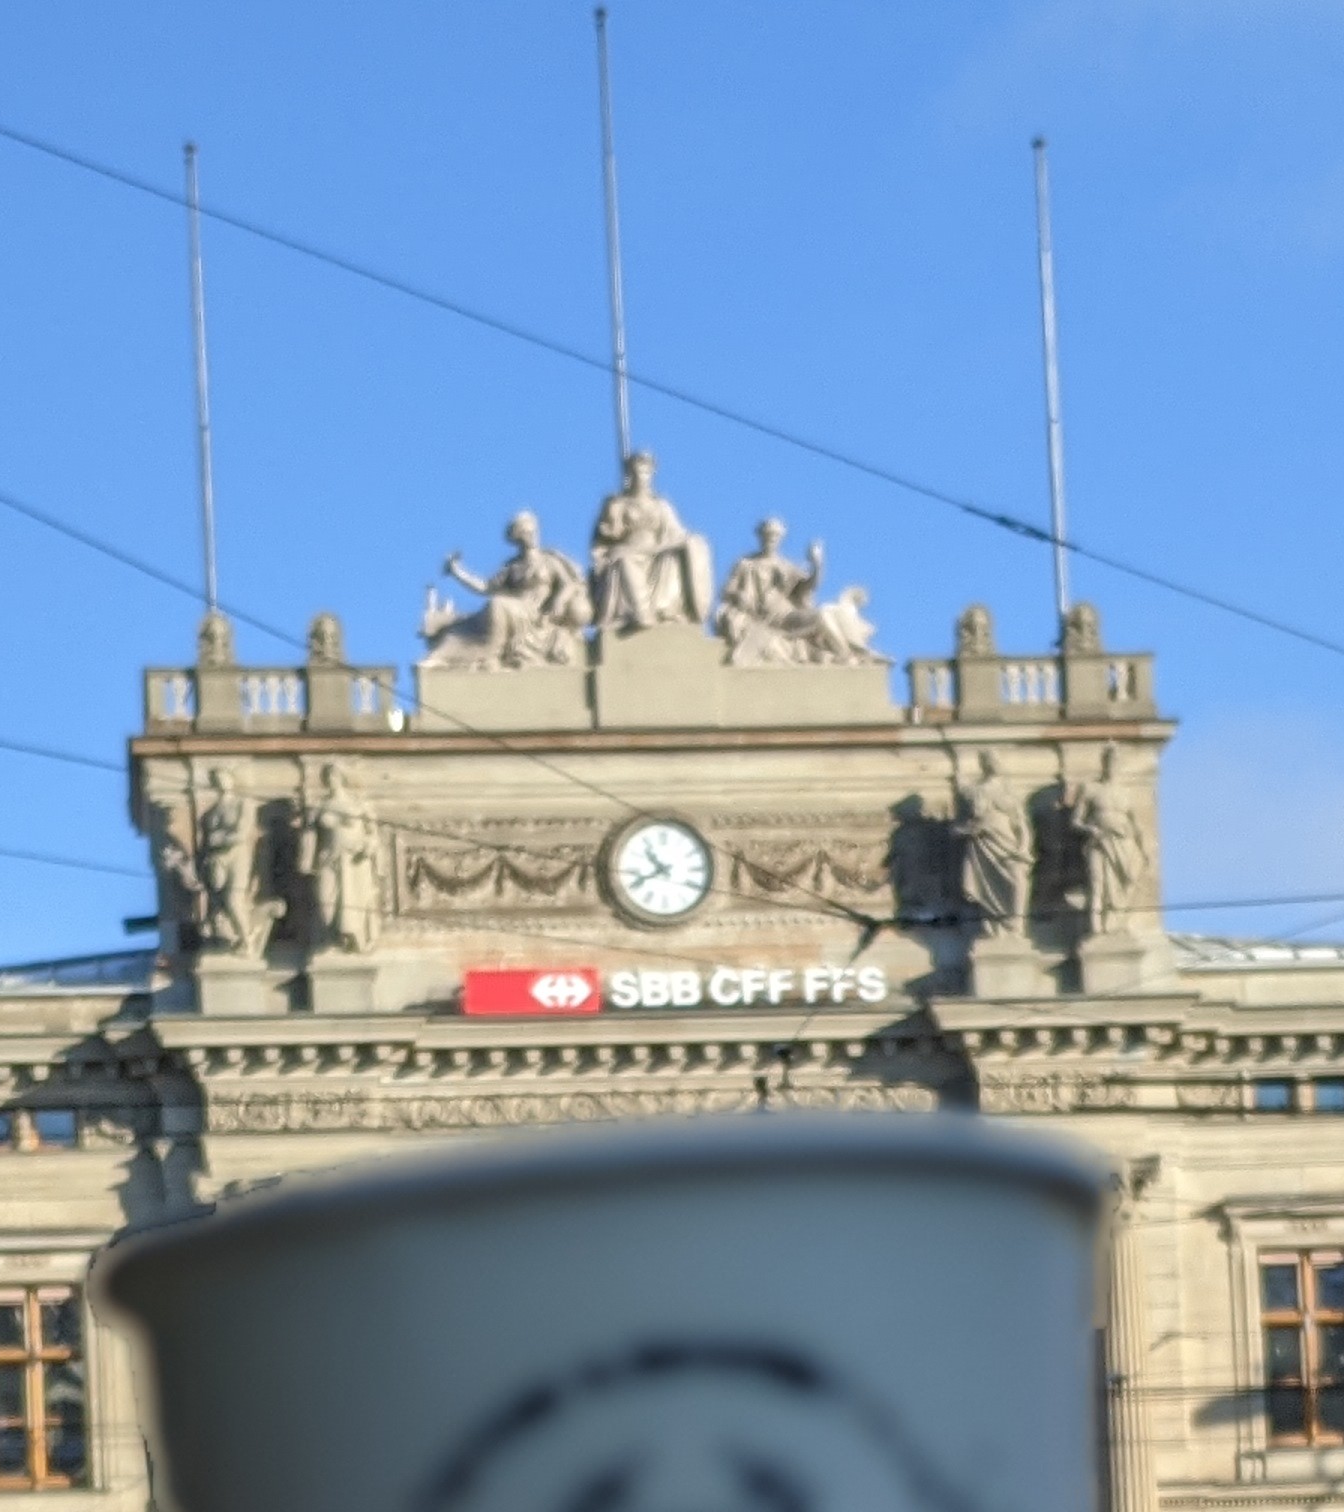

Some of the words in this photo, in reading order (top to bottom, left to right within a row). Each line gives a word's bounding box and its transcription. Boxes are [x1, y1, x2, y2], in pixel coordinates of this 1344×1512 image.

[610, 969, 702, 1009] SBB
[709, 966, 795, 1006] CFF
[803, 965, 887, 1004] FFS
